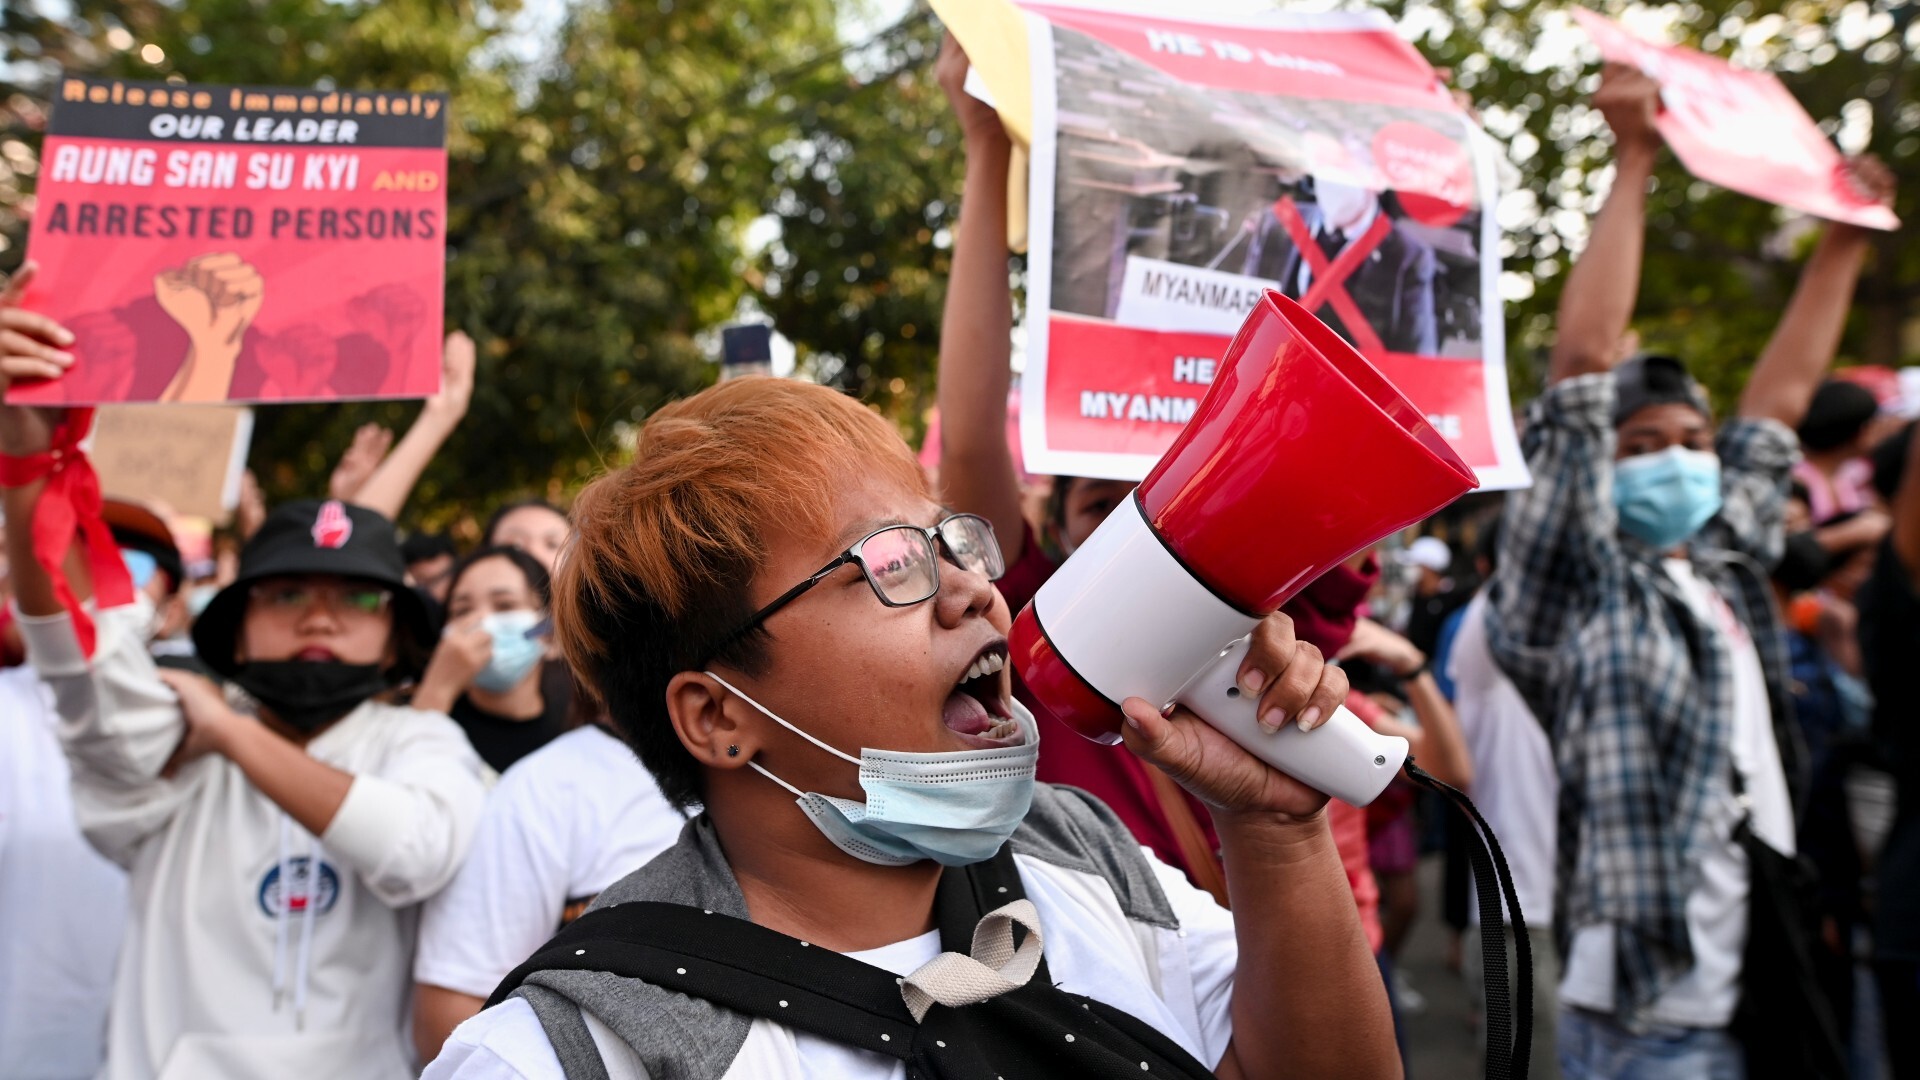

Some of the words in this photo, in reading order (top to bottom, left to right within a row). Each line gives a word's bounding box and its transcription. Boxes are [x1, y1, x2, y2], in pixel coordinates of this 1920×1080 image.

[62, 79, 213, 110] Release
[229, 87, 441, 120] Immediately
[149, 113, 225, 140] OUR
[232, 116, 359, 143] LEADER
[51, 144, 157, 187] AUNG
[164, 149, 238, 189] SAN
[245, 151, 295, 190] SU
[302, 153, 360, 191] KYI
[371, 170, 440, 193] AND
[46, 201, 255, 240] ARRESTED
[270, 207, 437, 241] PERSONS
[1173, 355, 1217, 385] HE
[1079, 390, 1199, 424] MYANM
